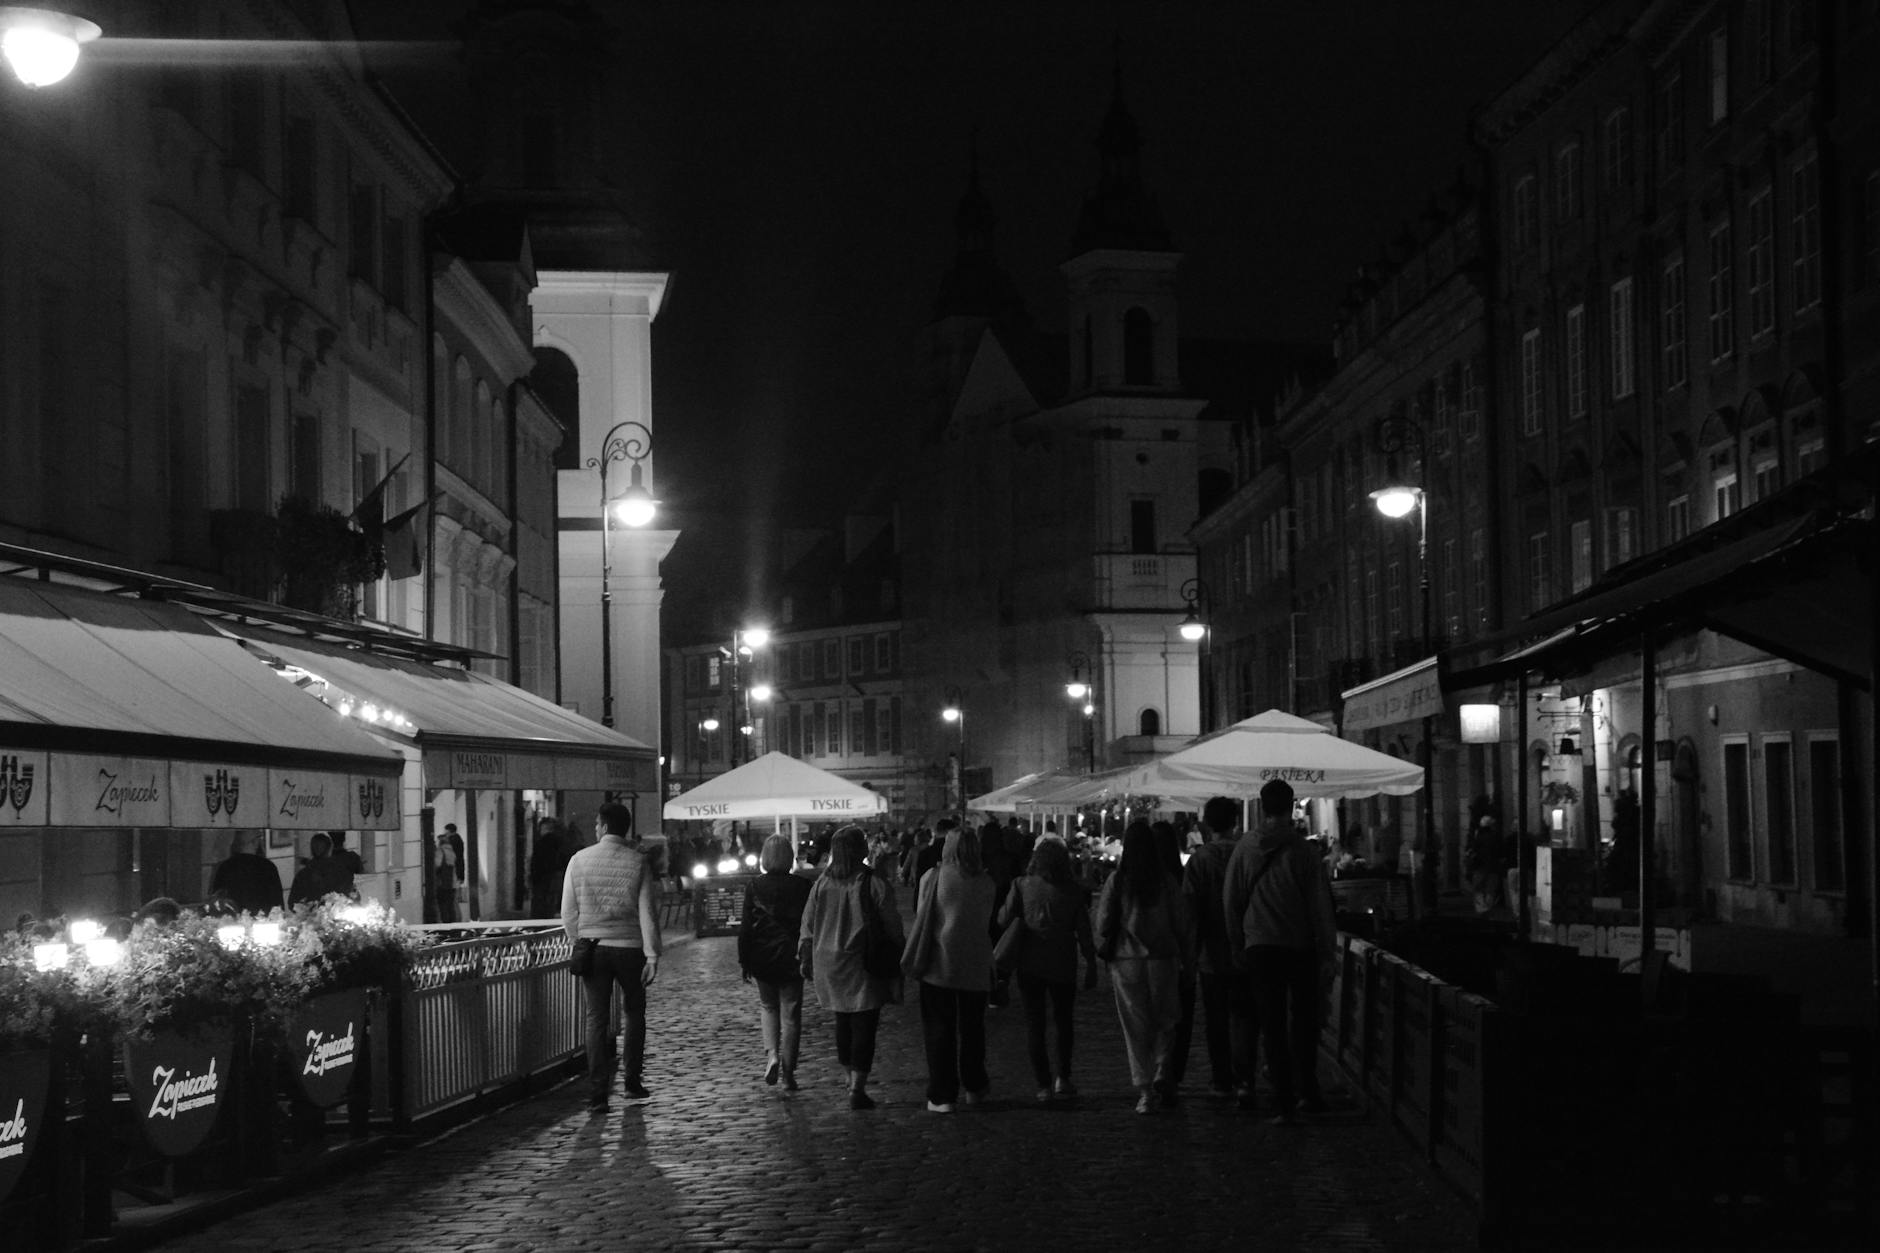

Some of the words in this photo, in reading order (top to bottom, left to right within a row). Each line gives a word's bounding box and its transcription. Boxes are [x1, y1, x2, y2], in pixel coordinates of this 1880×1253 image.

[1260, 769, 1325, 783] PASIEKA
[96, 768, 160, 817] Zapiecek
[688, 804, 730, 816] TYSKIE
[810, 799, 853, 810] TYSKIE
[148, 1056, 218, 1119] Zapiecek
